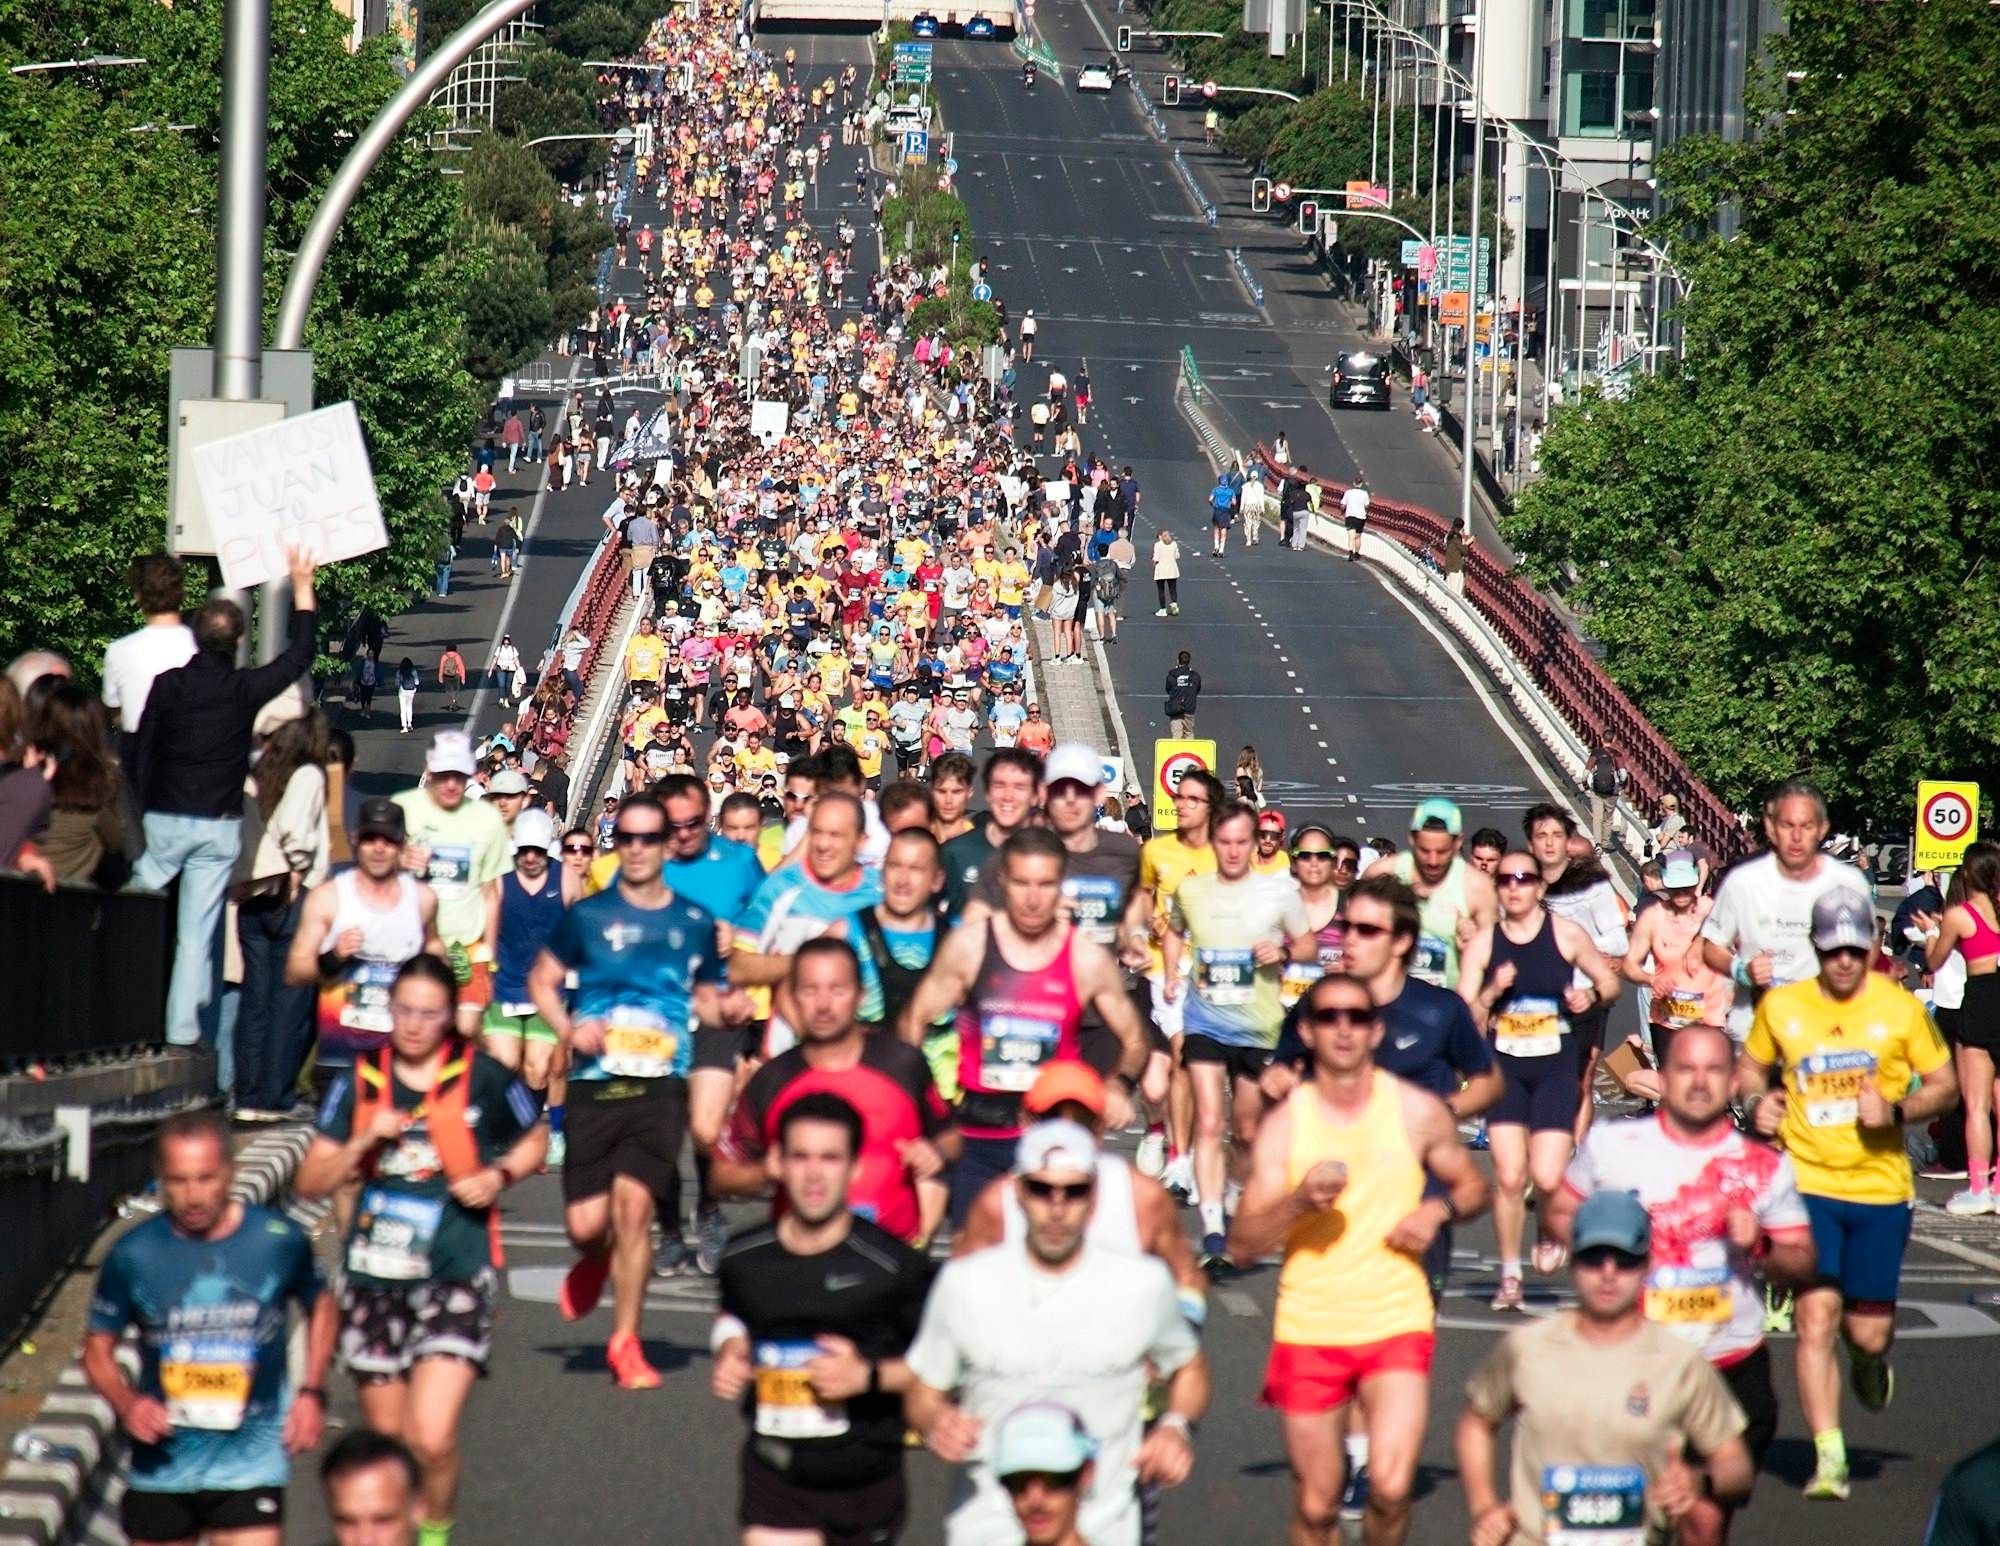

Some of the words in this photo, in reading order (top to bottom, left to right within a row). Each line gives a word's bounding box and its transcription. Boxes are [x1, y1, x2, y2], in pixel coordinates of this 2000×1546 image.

[220, 454, 339, 519] JUAN
[1934, 808, 1961, 825] 50
[1828, 1052, 1871, 1069] ZURICH
